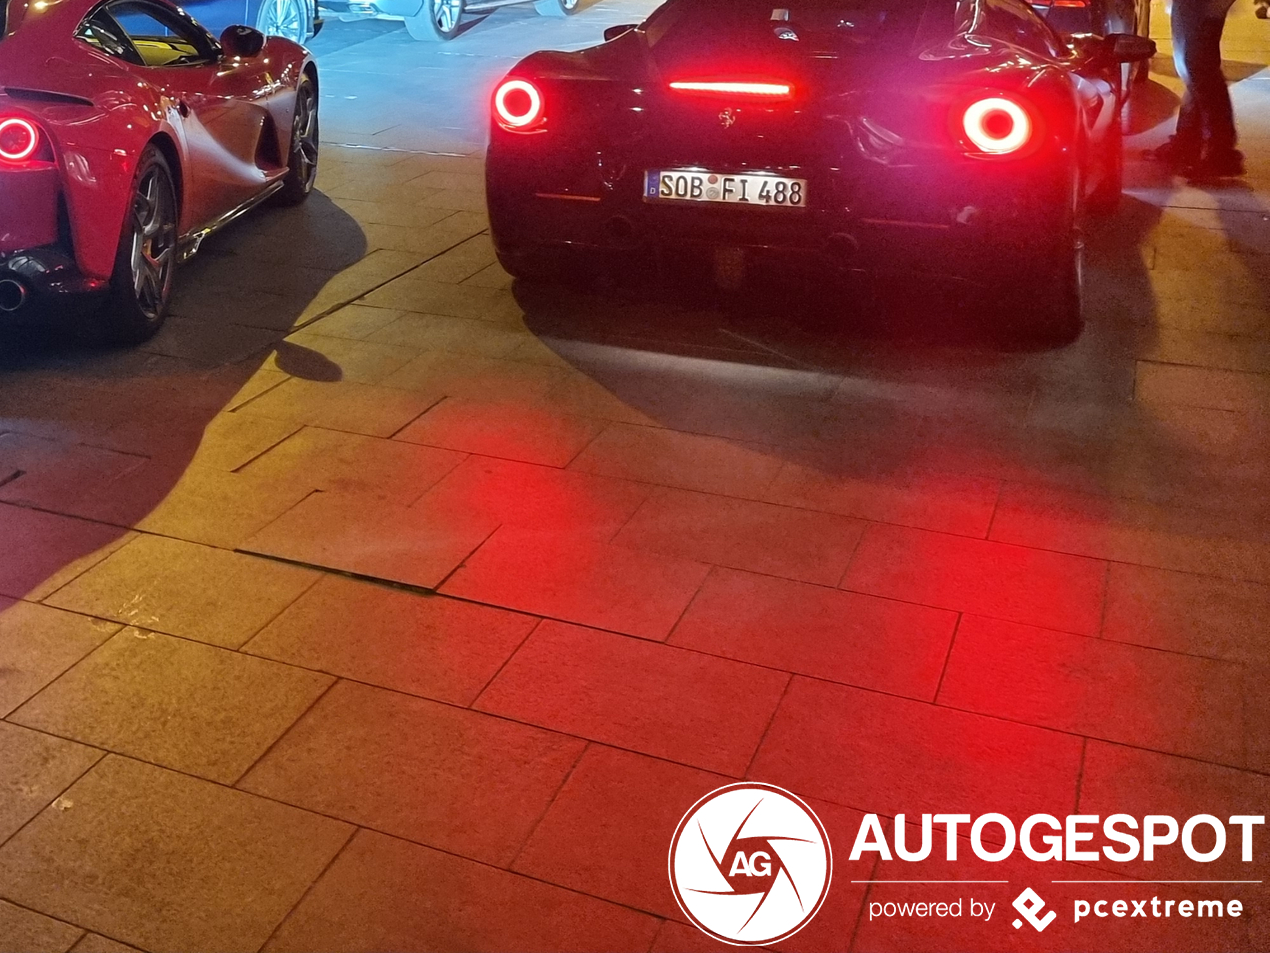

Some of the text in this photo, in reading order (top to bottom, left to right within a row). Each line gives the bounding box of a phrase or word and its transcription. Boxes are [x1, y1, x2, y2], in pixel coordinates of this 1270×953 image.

[660, 174, 703, 199] SOB
[722, 178, 749, 202] FI
[758, 180, 802, 205] 488
